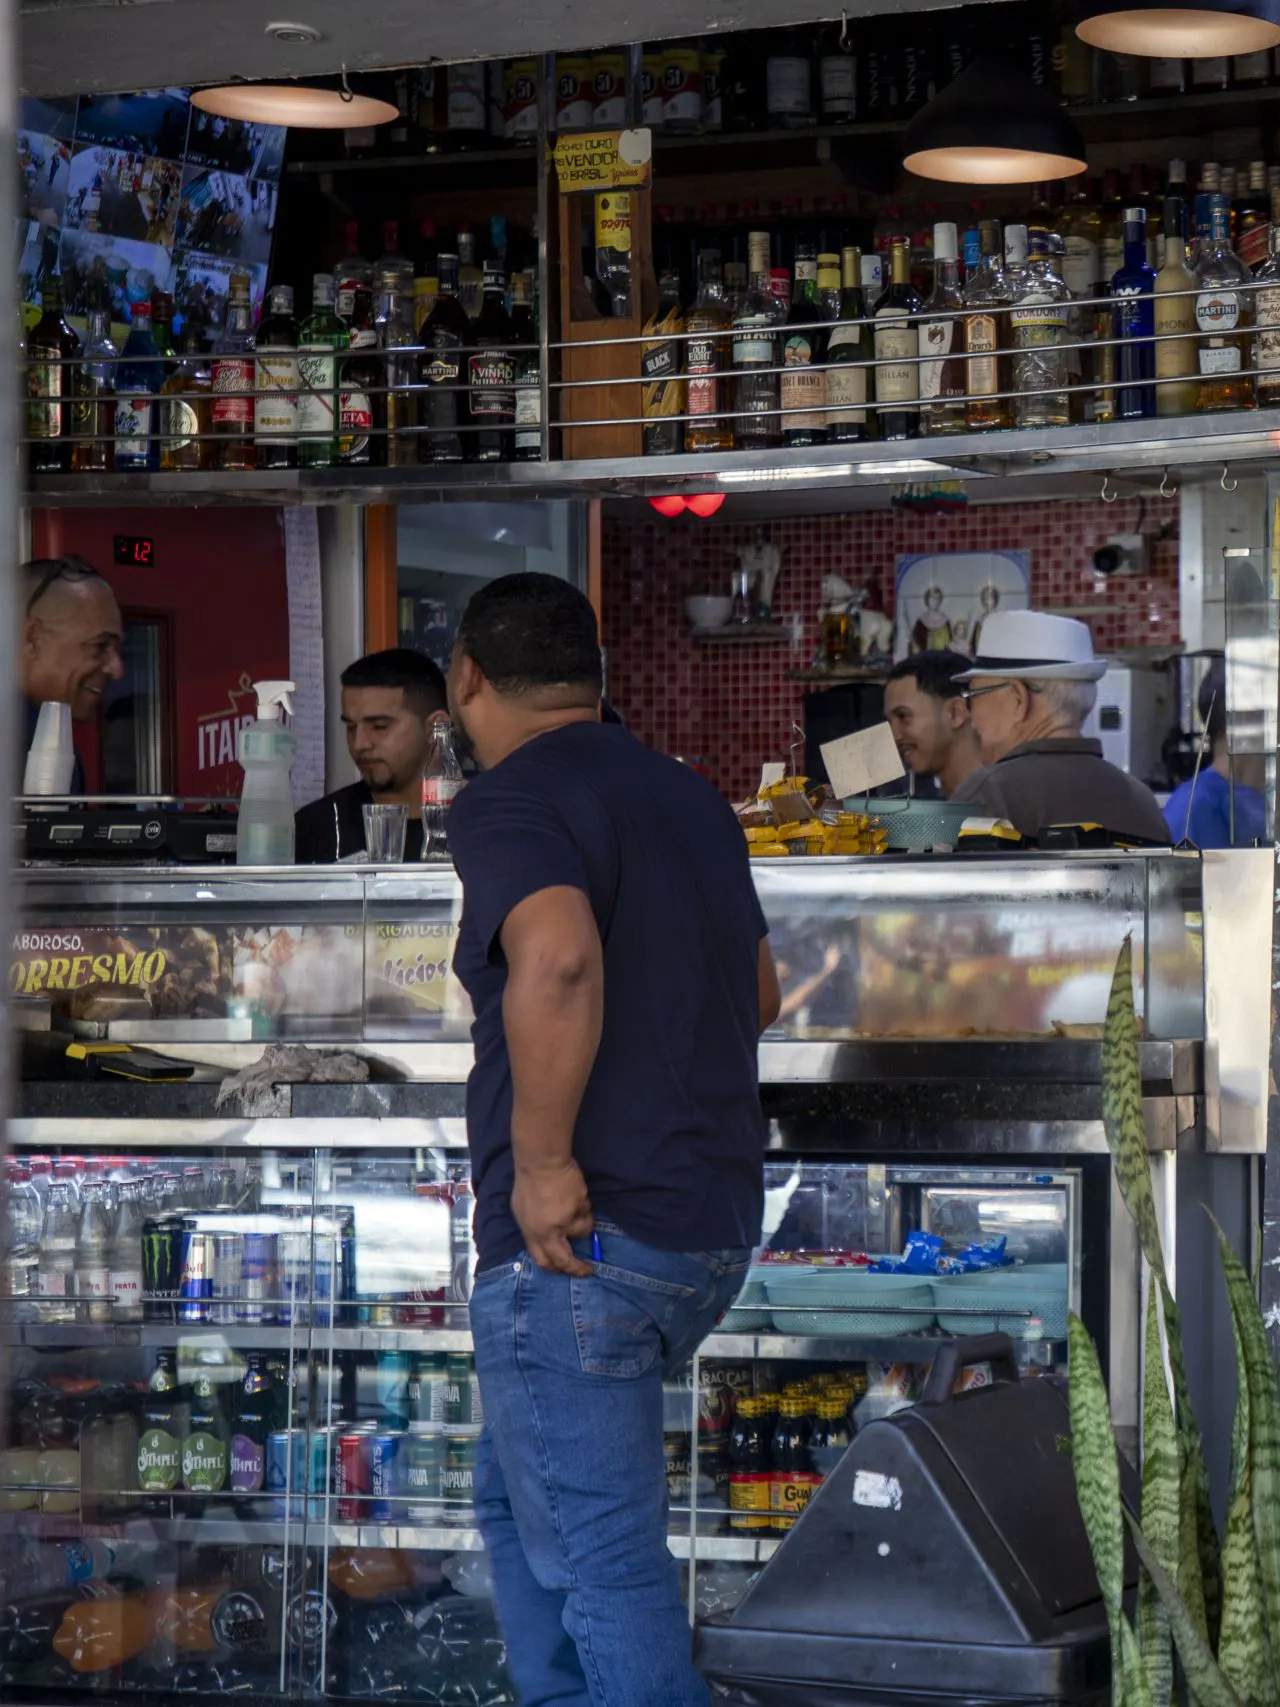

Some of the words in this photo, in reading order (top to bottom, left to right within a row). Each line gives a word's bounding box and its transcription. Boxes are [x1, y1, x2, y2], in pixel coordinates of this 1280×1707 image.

[561, 78, 577, 96] 51
[597, 73, 614, 93] 51
[667, 68, 683, 88] 51
[517, 80, 535, 99] 51
[1198, 305, 1237, 316] MARTINI
[421, 365, 458, 377] MARTINI
[646, 351, 671, 373] BLACK
[11, 934, 85, 953] ABOROSO,
[8, 951, 166, 993] ORRESMO
